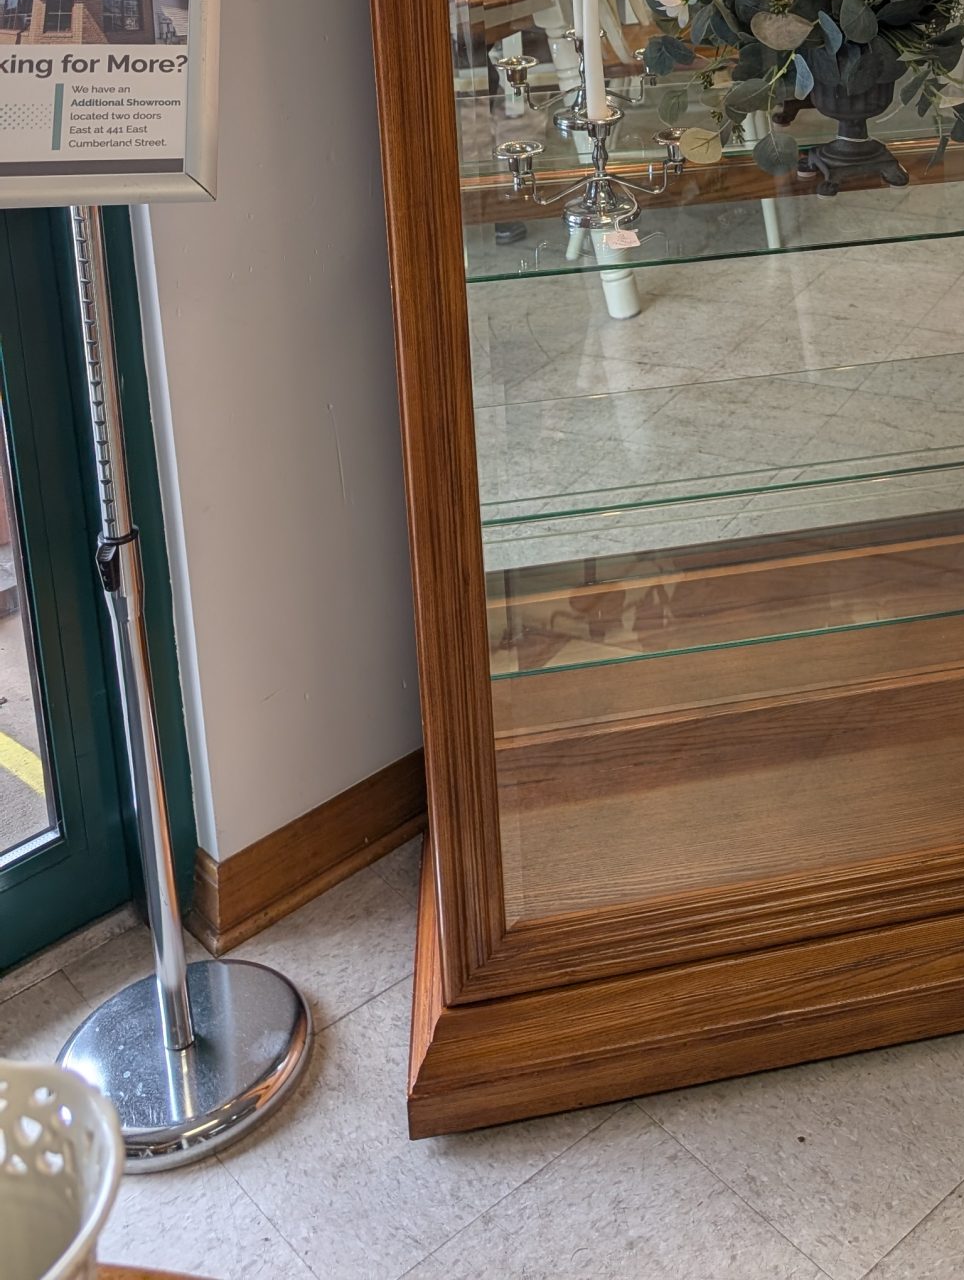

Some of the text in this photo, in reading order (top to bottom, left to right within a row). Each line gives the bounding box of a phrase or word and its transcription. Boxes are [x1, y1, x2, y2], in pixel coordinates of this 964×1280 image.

[62, 54, 101, 73] for
[107, 54, 188, 73] More?
[72, 85, 89, 93] We
[92, 85, 116, 93] have
[71, 99, 124, 107] Additional
[70, 112, 109, 120] located
[132, 112, 161, 120] doors
[69, 125, 148, 136] East at 441 East
[68, 138, 167, 148] Cumberland Street.
